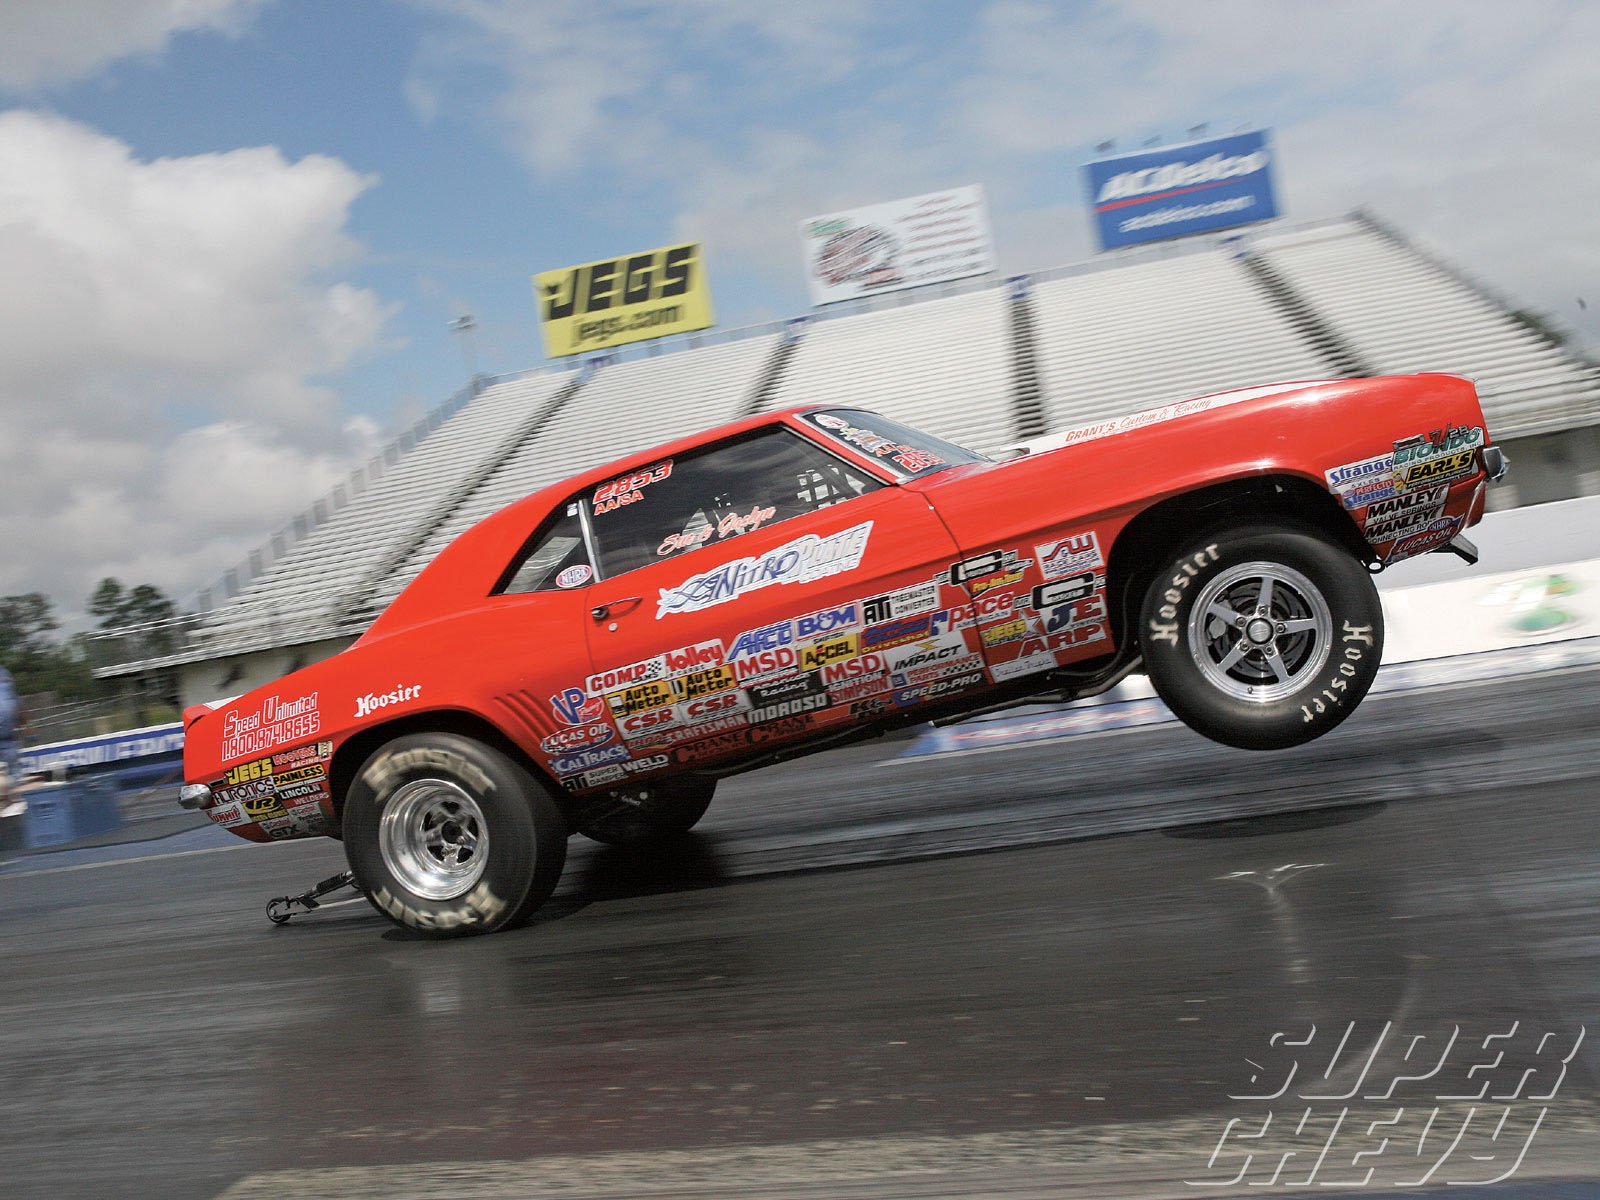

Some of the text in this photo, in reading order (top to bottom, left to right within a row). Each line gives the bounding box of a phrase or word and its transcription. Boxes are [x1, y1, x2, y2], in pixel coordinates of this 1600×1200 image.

[543, 245, 698, 321] JEGS
[1065, 421, 1117, 442] GRANT'S
[1120, 413, 1157, 428] Custom
[1174, 400, 1212, 416] Racing
[1330, 457, 1392, 483] Strange
[1409, 452, 1471, 481] EARL'S
[593, 460, 674, 504] 2853
[1368, 487, 1437, 517] MANLEY
[1365, 508, 1437, 538] MANLEY
[1151, 543, 1220, 647] Hoosier
[799, 606, 856, 637] B&M
[948, 592, 1014, 633] pace
[1020, 624, 1101, 658] ARP
[739, 647, 795, 679] MSD
[825, 653, 881, 684] MSD
[894, 644, 962, 671] IMPACT
[1301, 619, 1374, 723] Hoosier
[590, 664, 647, 692] COMP
[686, 669, 722, 684] Auto
[687, 677, 732, 700] Meter
[900, 673, 981, 701] SPEED-PRO
[354, 684, 422, 718] Hoosier
[550, 687, 586, 724] VP
[625, 685, 659, 701] Auto
[625, 694, 670, 715] Meter
[687, 694, 737, 717] CSR
[224, 692, 318, 738] Speed Unlimited
[624, 708, 673, 731] CSR
[749, 693, 828, 723] MOROSO
[222, 711, 320, 762] 1.800.874.8655
[544, 729, 585, 746] LUCAS
[272, 745, 318, 766] HOOTERS
[622, 754, 669, 773] WELD
[226, 758, 273, 785] JEG'S
[273, 766, 323, 785] PAINLESS
[281, 784, 321, 799] LINCOLN
